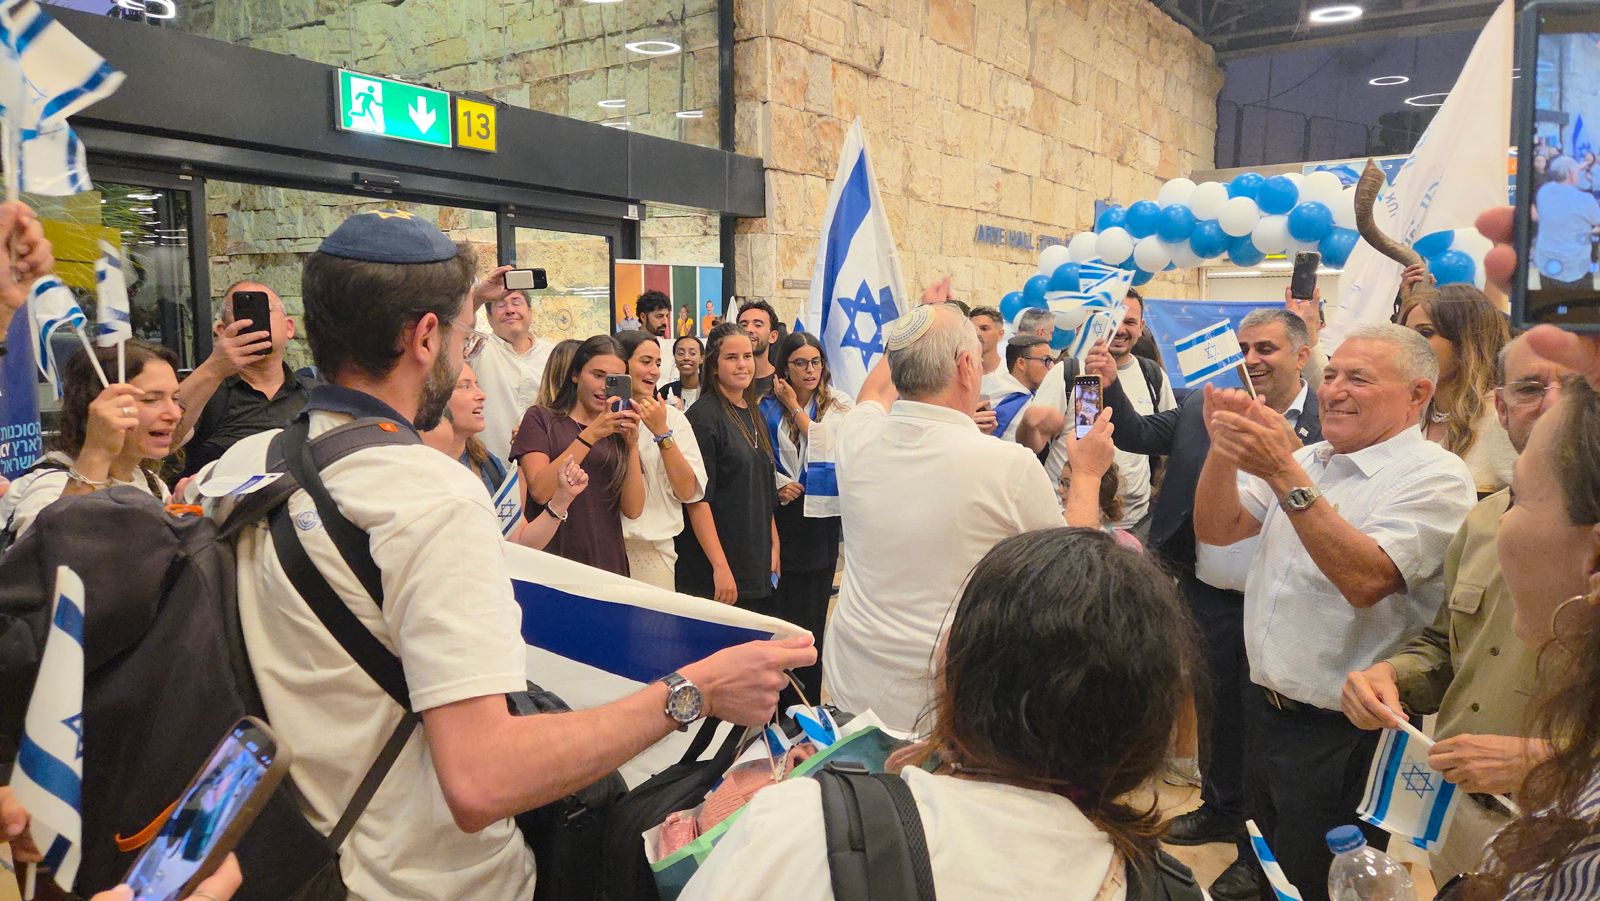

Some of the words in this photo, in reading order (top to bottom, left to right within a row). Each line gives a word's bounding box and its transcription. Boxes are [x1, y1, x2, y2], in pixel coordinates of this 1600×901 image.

[463, 110, 490, 140] 13
[0, 421, 41, 441] הסוכנות
[11, 435, 42, 457] לארץ
